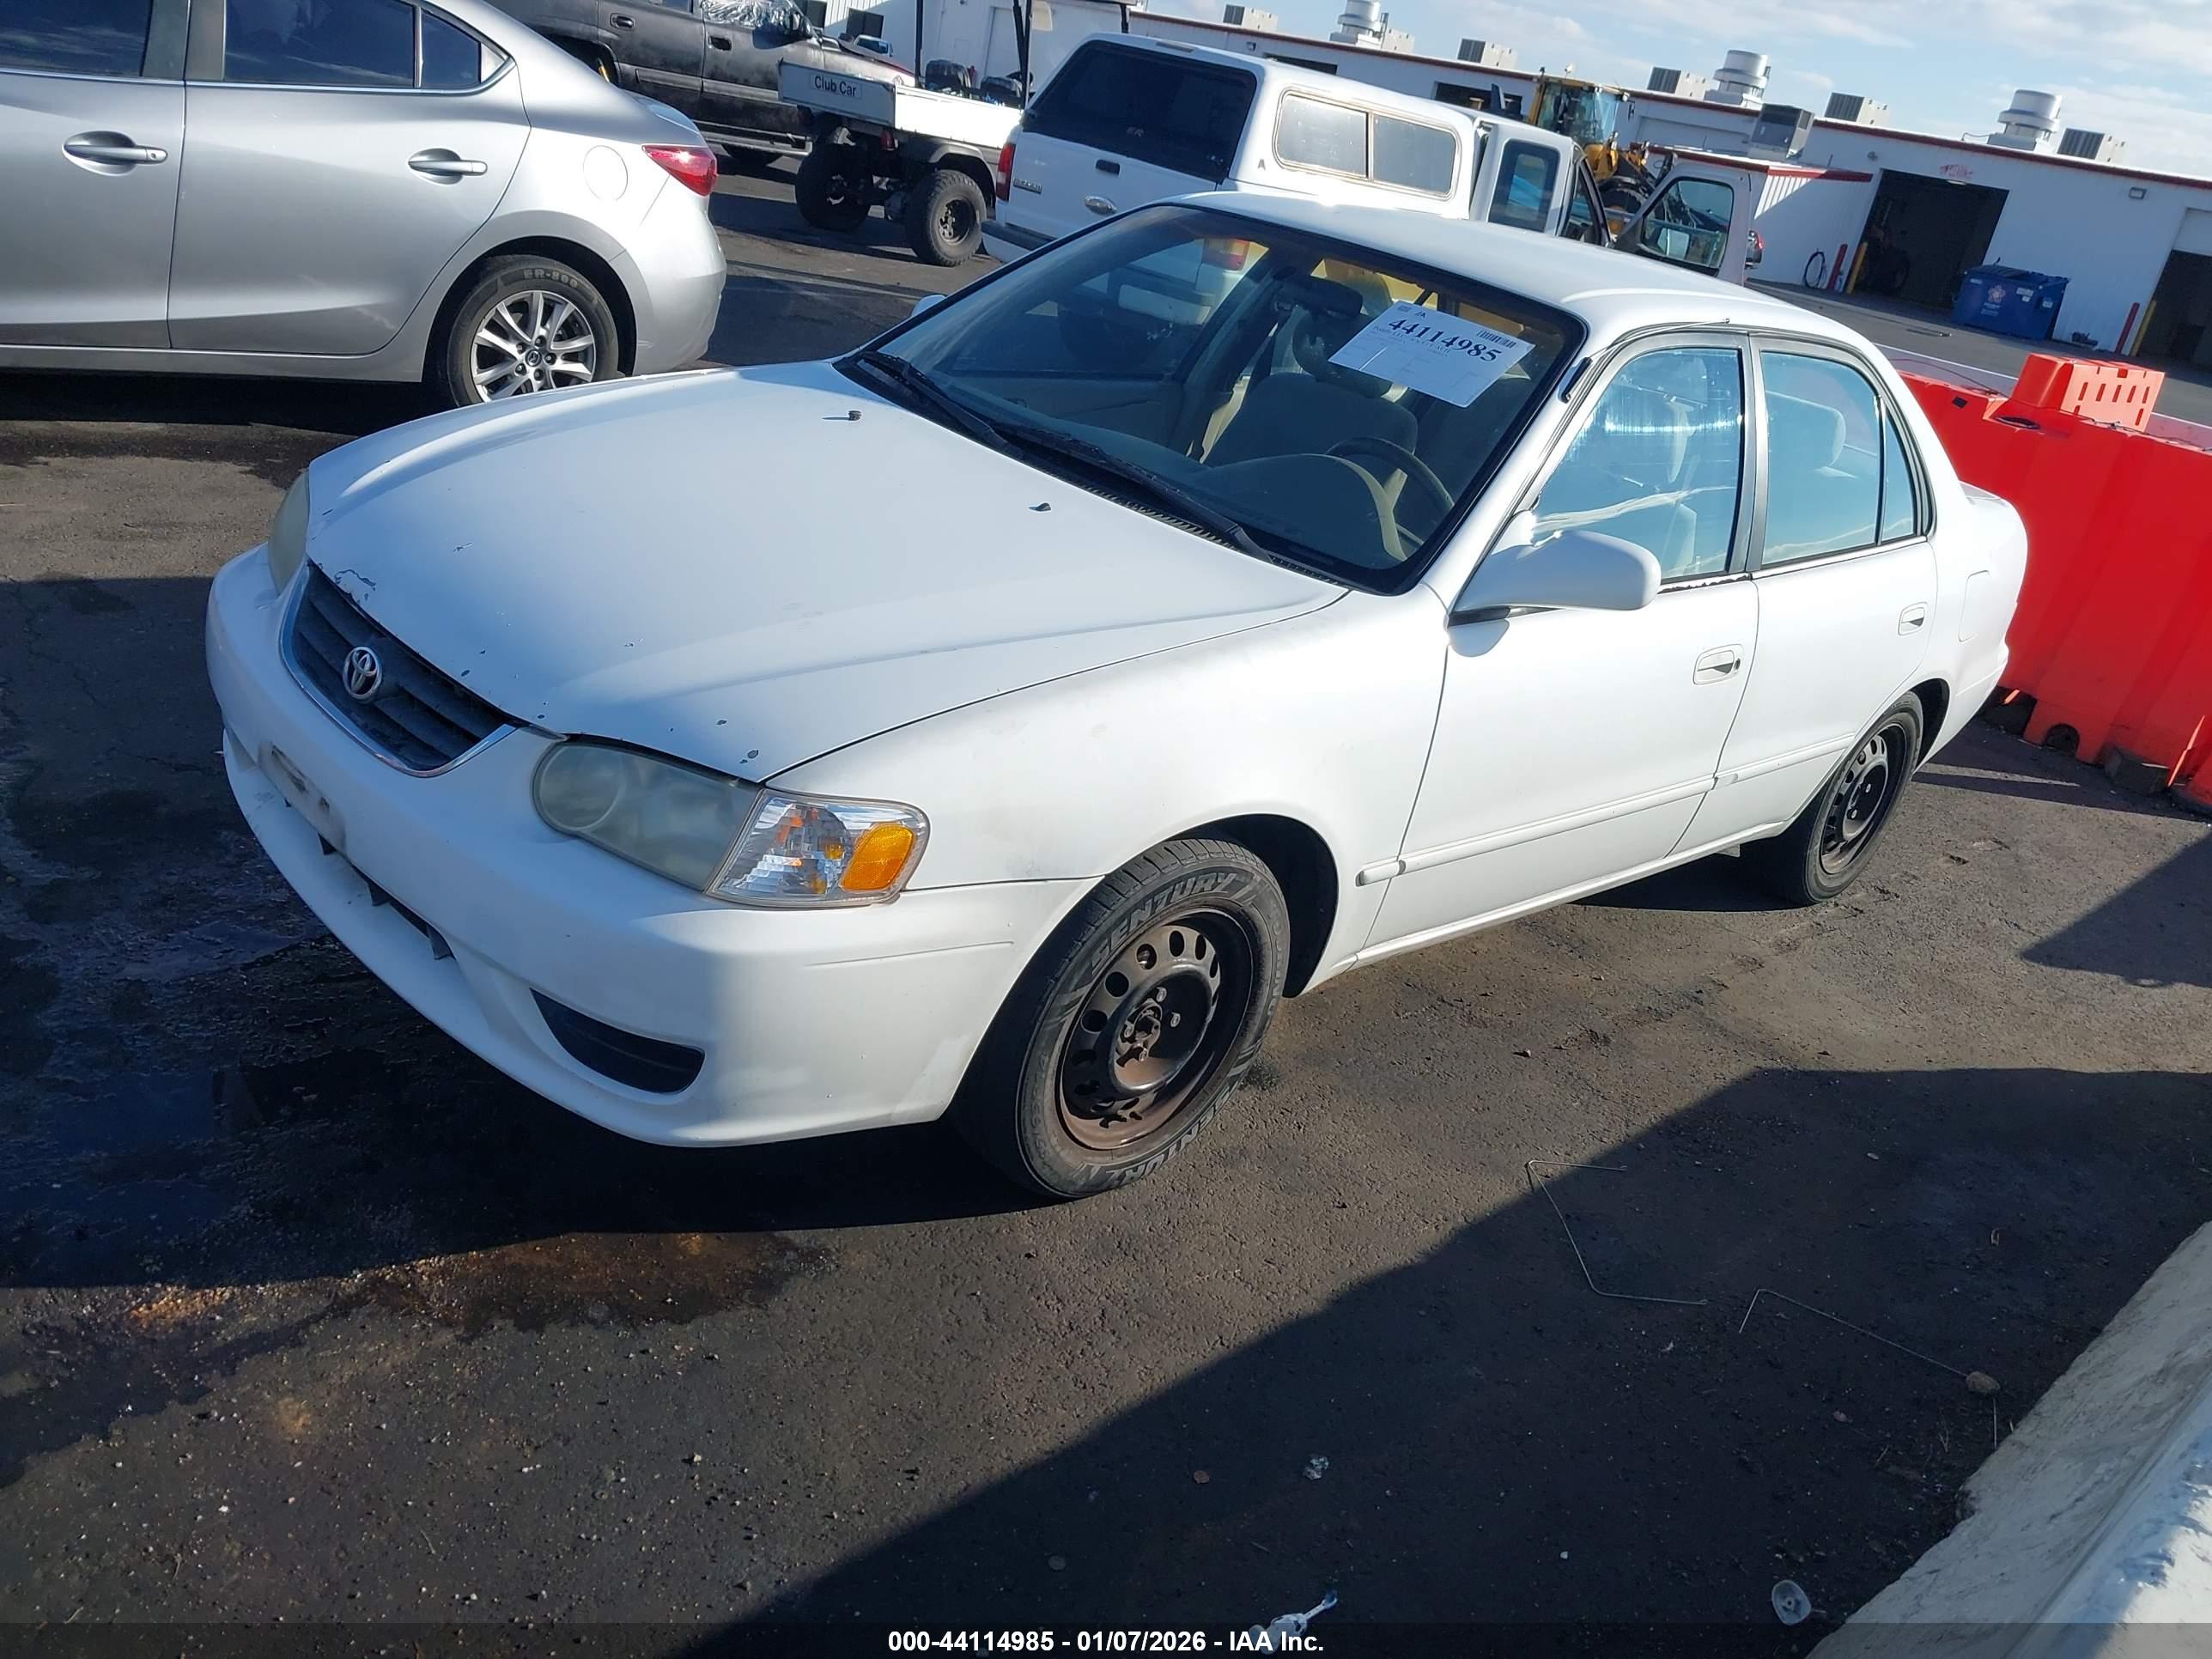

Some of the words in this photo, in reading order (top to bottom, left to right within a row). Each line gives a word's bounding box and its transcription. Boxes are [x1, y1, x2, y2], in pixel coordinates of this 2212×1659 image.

[814, 76, 836, 93] Club
[839, 81, 857, 97] Car
[1388, 319, 1503, 362] 44114985
